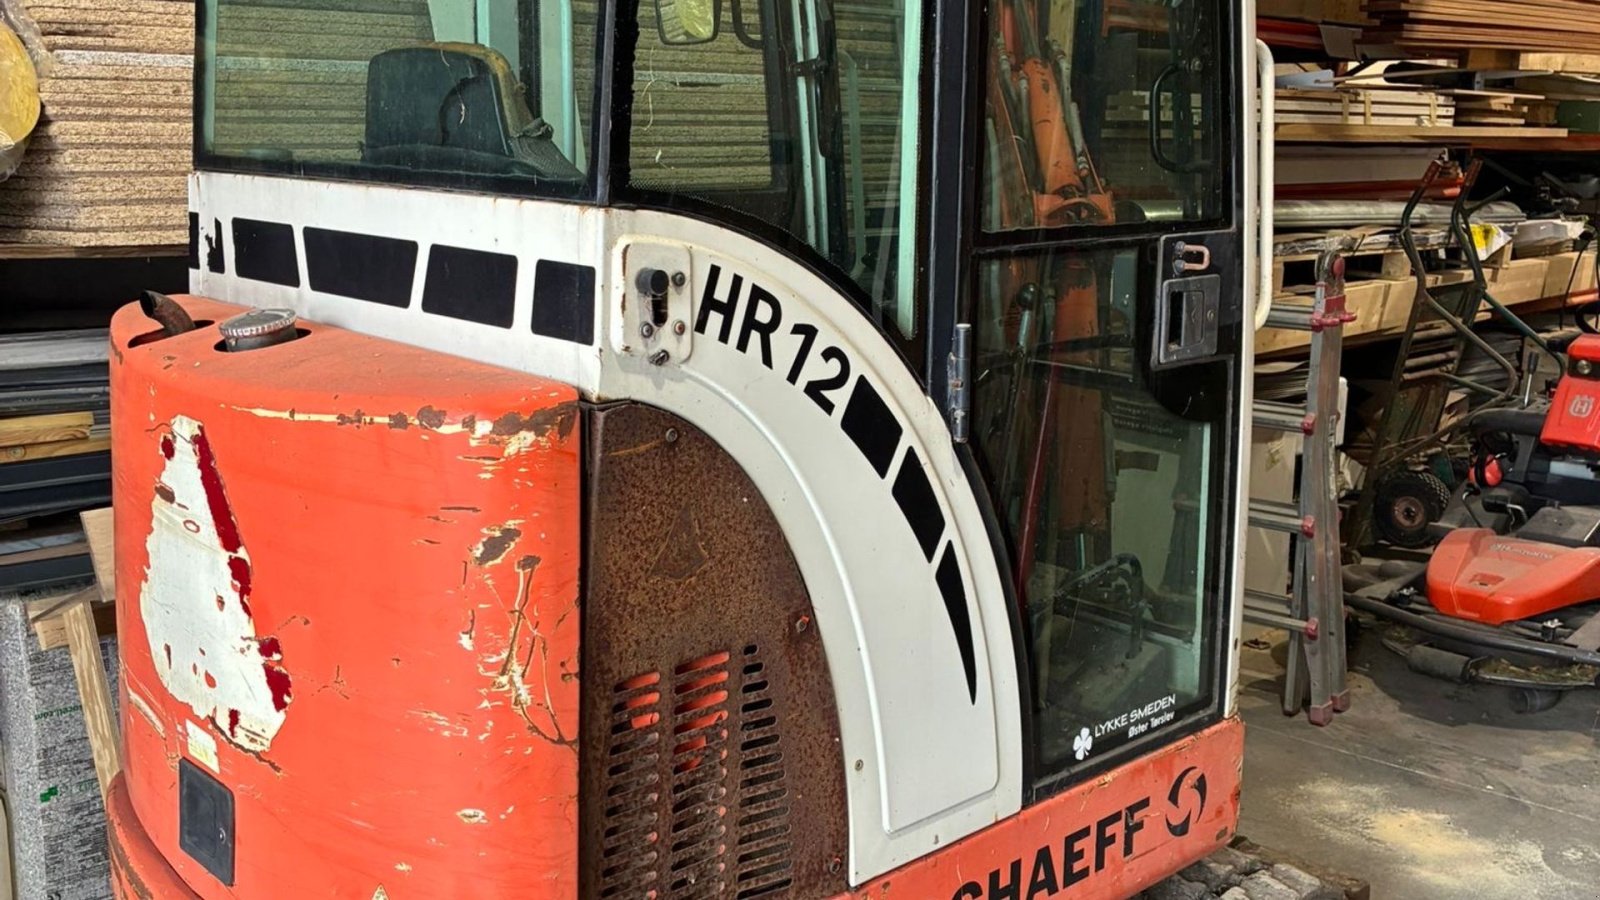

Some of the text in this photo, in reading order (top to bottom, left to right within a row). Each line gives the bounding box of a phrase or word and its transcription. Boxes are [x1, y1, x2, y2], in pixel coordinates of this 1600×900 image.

[694, 263, 851, 417] HR12
[1095, 693, 1176, 738] LYKKE SMEDEN
